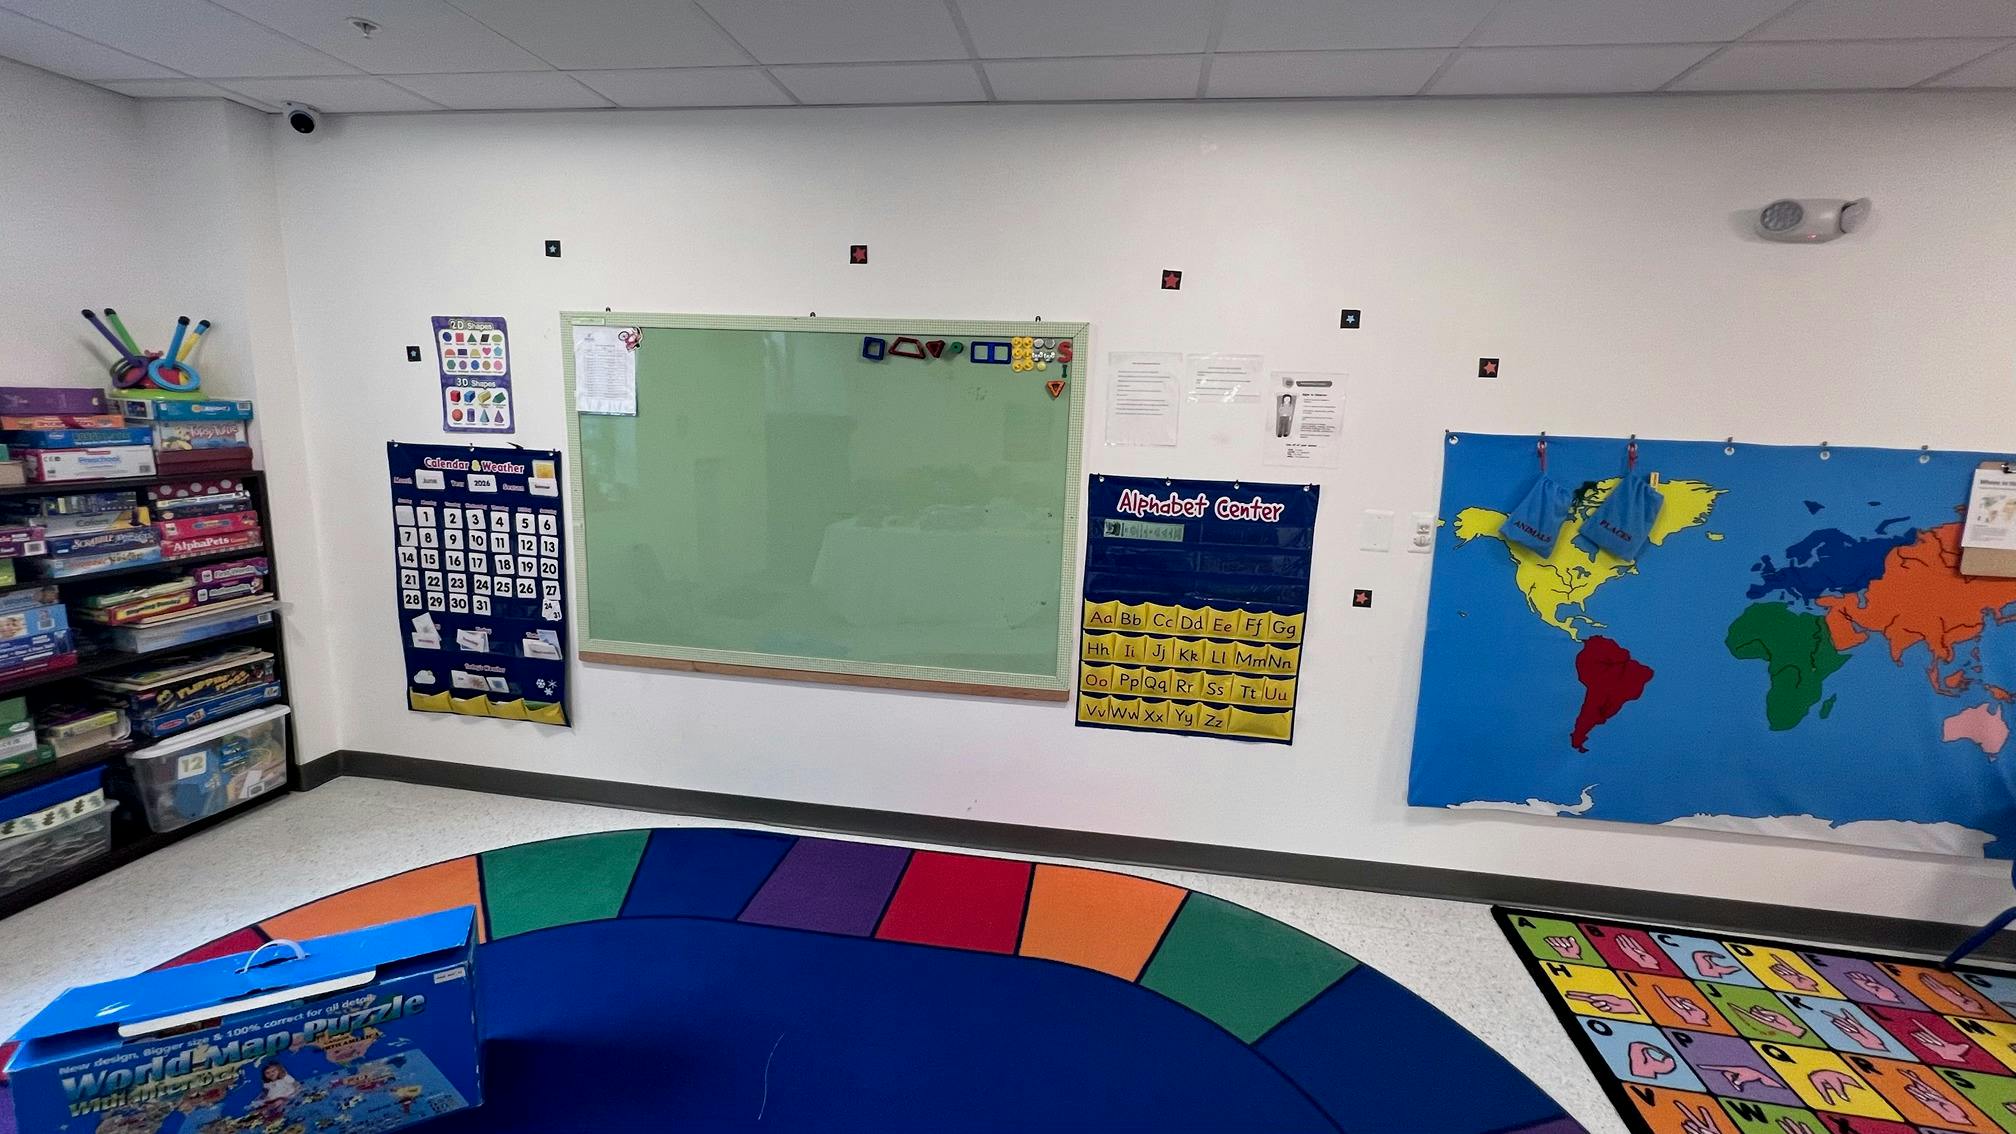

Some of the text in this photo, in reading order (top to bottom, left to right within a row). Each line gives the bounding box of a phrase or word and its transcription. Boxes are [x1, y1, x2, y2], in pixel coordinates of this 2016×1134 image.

[450, 321, 492, 331] 2D Shapes
[457, 378, 496, 388] 3D Shapes
[424, 457, 524, 474] Calendar Weather
[1118, 489, 1284, 522] Alphabet Center
[424, 512, 550, 530] 1 2 3 4 5 6
[1514, 521, 1552, 542] ANIMALS
[1600, 520, 1631, 541] PLACES
[173, 537, 229, 551] AlphaPets
[405, 532, 555, 552] 7 8 9 10 11 12 13
[402, 552, 556, 574] 14 15 16 17 18 19 20
[405, 574, 556, 595] 21 22 23 24 25 26 27
[406, 594, 419, 605] 28
[430, 597, 442, 607] 29
[452, 598, 466, 609] 30
[477, 600, 487, 611] 31
[1090, 612, 1296, 638] Aa Bb Cc Dd Ee Ff Gg
[1087, 643, 1291, 668] Hh Ii Jj Kk Ll Mm Nn
[1086, 674, 1287, 701] Oo Pp Qq Rr Ss Tt Uu
[1087, 704, 1222, 728] Vv Ww Xx Yy Zz
[182, 757, 203, 772] 12
[1517, 916, 1536, 929] A
[1585, 926, 1604, 937] B
[1658, 934, 1679, 947] C
[1729, 944, 1754, 956] D
[1804, 953, 1829, 967] E
[1963, 973, 1992, 988] G
[1546, 961, 1573, 978] H
[1706, 984, 1722, 998] J
[1782, 994, 1814, 1010] K
[1866, 1005, 1894, 1021] L
[1953, 1017, 1997, 1036] M
[59, 1062, 91, 1075] New
[143, 1041, 184, 1058] Bigger
[187, 1037, 209, 1046] size
[226, 1022, 262, 1038] 100%
[264, 1013, 304, 1029] correct
[307, 1007, 323, 1017] for
[326, 1003, 340, 1014] all
[62, 1050, 194, 1100] World
[204, 1030, 290, 1067] Map
[303, 994, 425, 1043] Puzzle
[1586, 1019, 1975, 1089] O P Q R S
[1630, 1085, 1655, 1107] V
[1730, 1100, 1768, 1124] W
